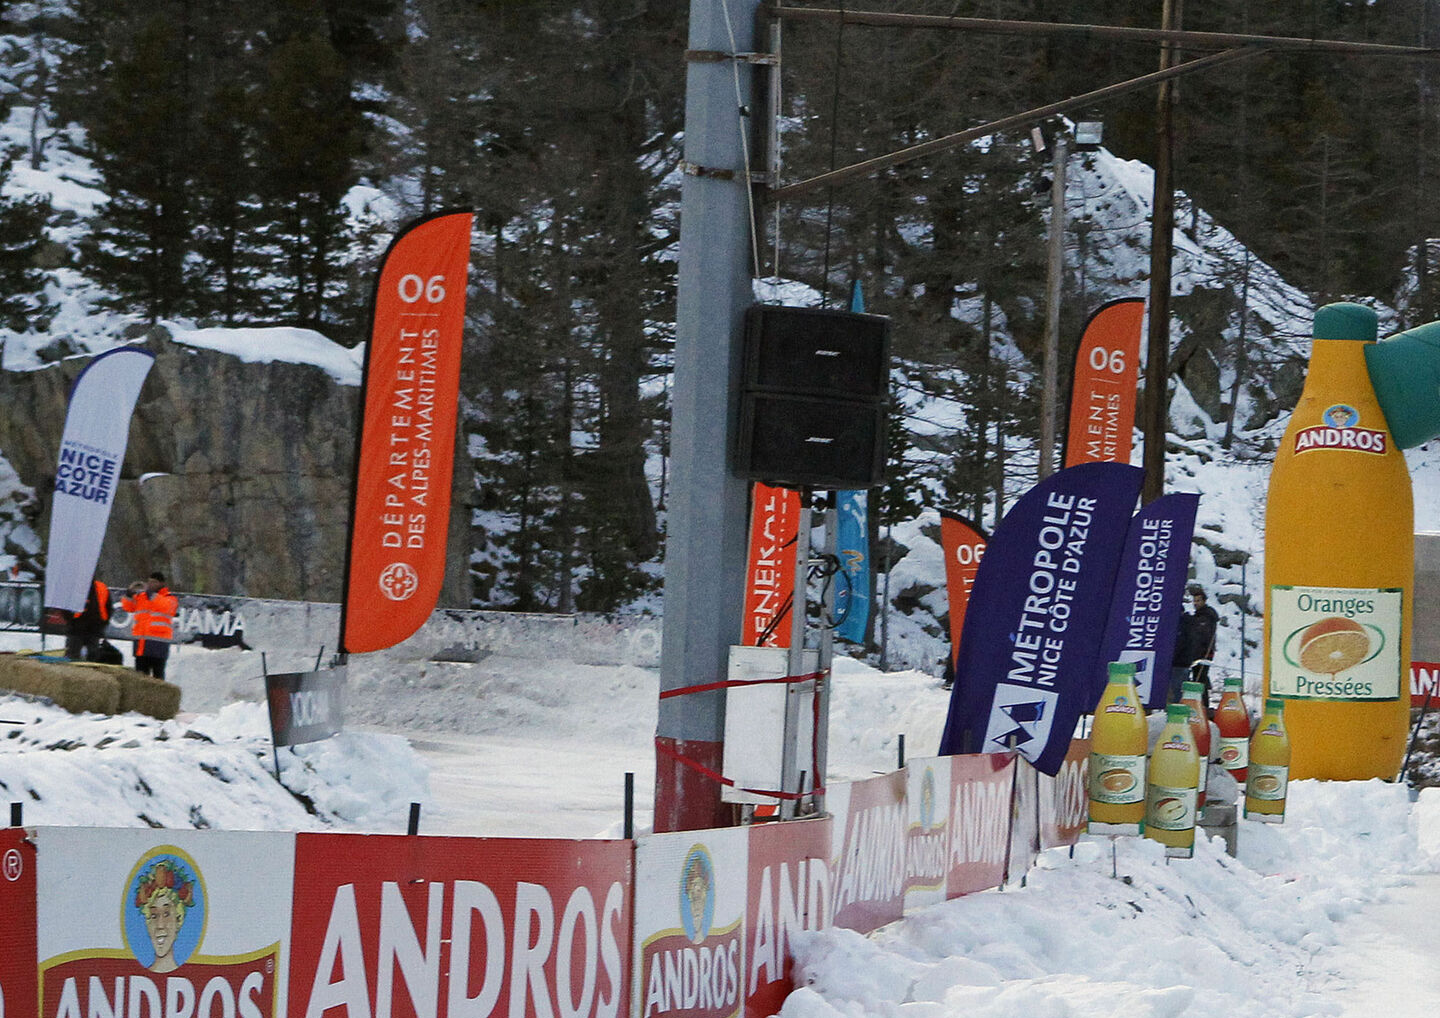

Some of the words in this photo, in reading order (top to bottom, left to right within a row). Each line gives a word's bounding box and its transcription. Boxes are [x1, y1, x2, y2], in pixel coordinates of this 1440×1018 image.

[398, 274, 446, 303] 06
[1089, 347, 1125, 374] 06
[379, 327, 420, 549] DÉPARTEMENT
[411, 328, 440, 507] ALPES-MARITIMES
[1296, 429, 1386, 452] ANDROS
[61, 448, 116, 475] NICE
[55, 479, 109, 505] AZUR
[407, 513, 427, 550] DES
[1063, 496, 1098, 575] D'AZUR
[1007, 491, 1075, 683] MÉTROPOLE
[1048, 579, 1077, 634] CÔTE
[1126, 517, 1160, 649] MÉTROPOLE
[1143, 615, 1160, 649] NICE
[1154, 518, 1174, 572] D'AZUR
[1297, 593, 1375, 618] Oranges
[1037, 637, 1064, 687] NICE
[1296, 676, 1373, 697] Pressées
[644, 938, 739, 1018] ANDROS
